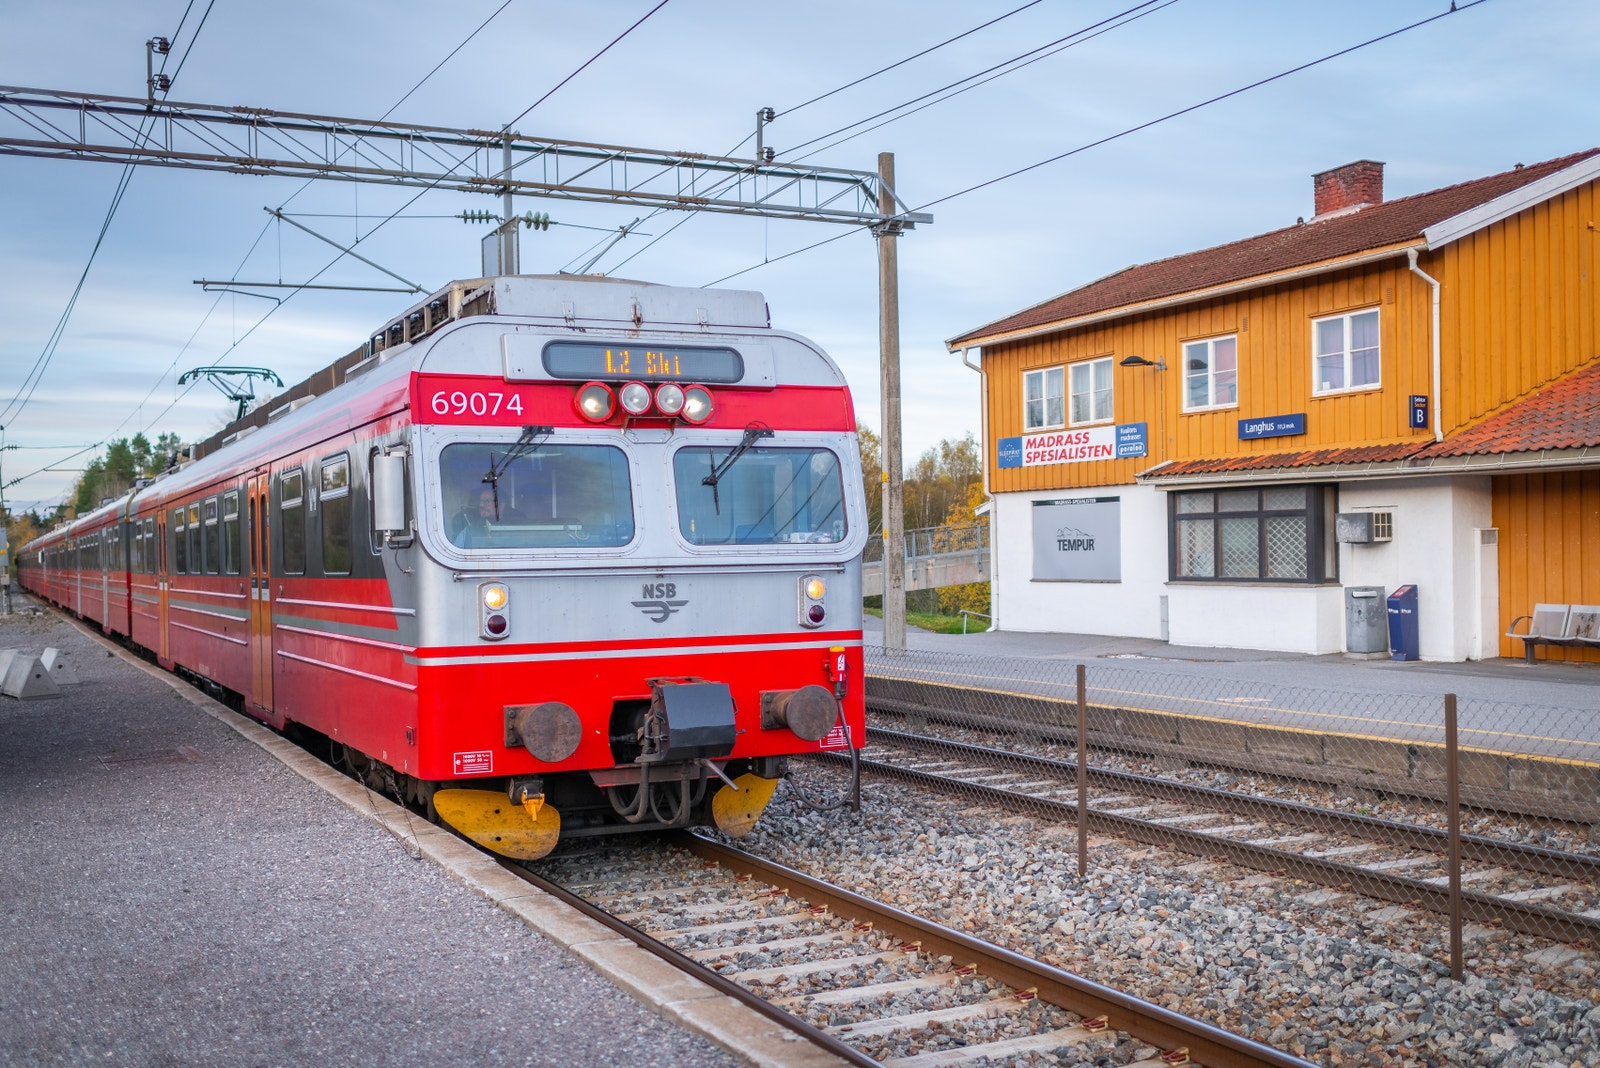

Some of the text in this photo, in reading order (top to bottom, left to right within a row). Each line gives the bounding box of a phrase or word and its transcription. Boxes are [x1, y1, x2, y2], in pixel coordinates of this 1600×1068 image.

[646, 351, 681, 375] Ski
[431, 391, 524, 416] 69074
[1416, 409, 1424, 423] B
[1245, 421, 1275, 435] Langhus
[1025, 431, 1090, 450] MADRASS
[1025, 443, 1113, 464] SPESIALISTEN
[1057, 539, 1095, 552] TEMPUR
[642, 583, 677, 599] NSB
